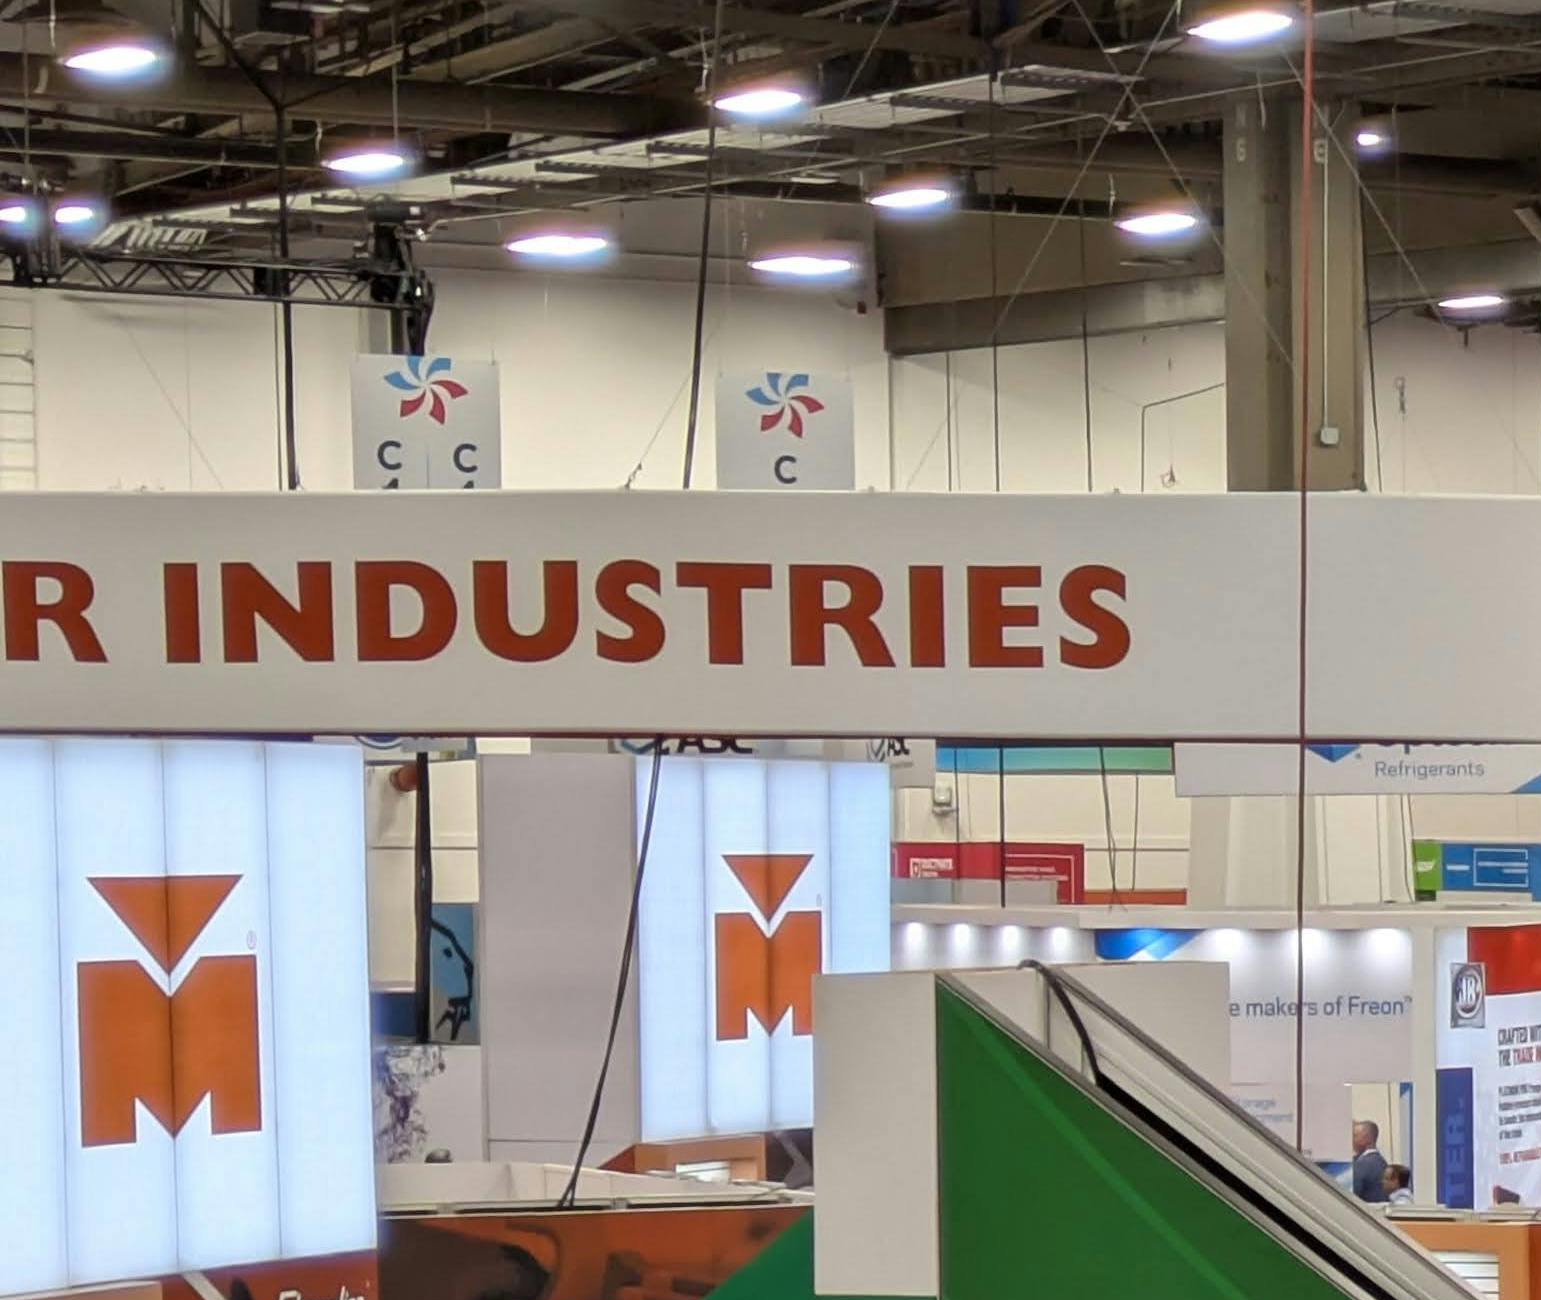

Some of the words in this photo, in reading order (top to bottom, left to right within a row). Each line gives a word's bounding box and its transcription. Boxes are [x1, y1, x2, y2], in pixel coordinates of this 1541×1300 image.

[1, 560, 107, 664] R
[163, 558, 1131, 670] INDUSTRIES
[1374, 760, 1485, 780] Refrigerants
